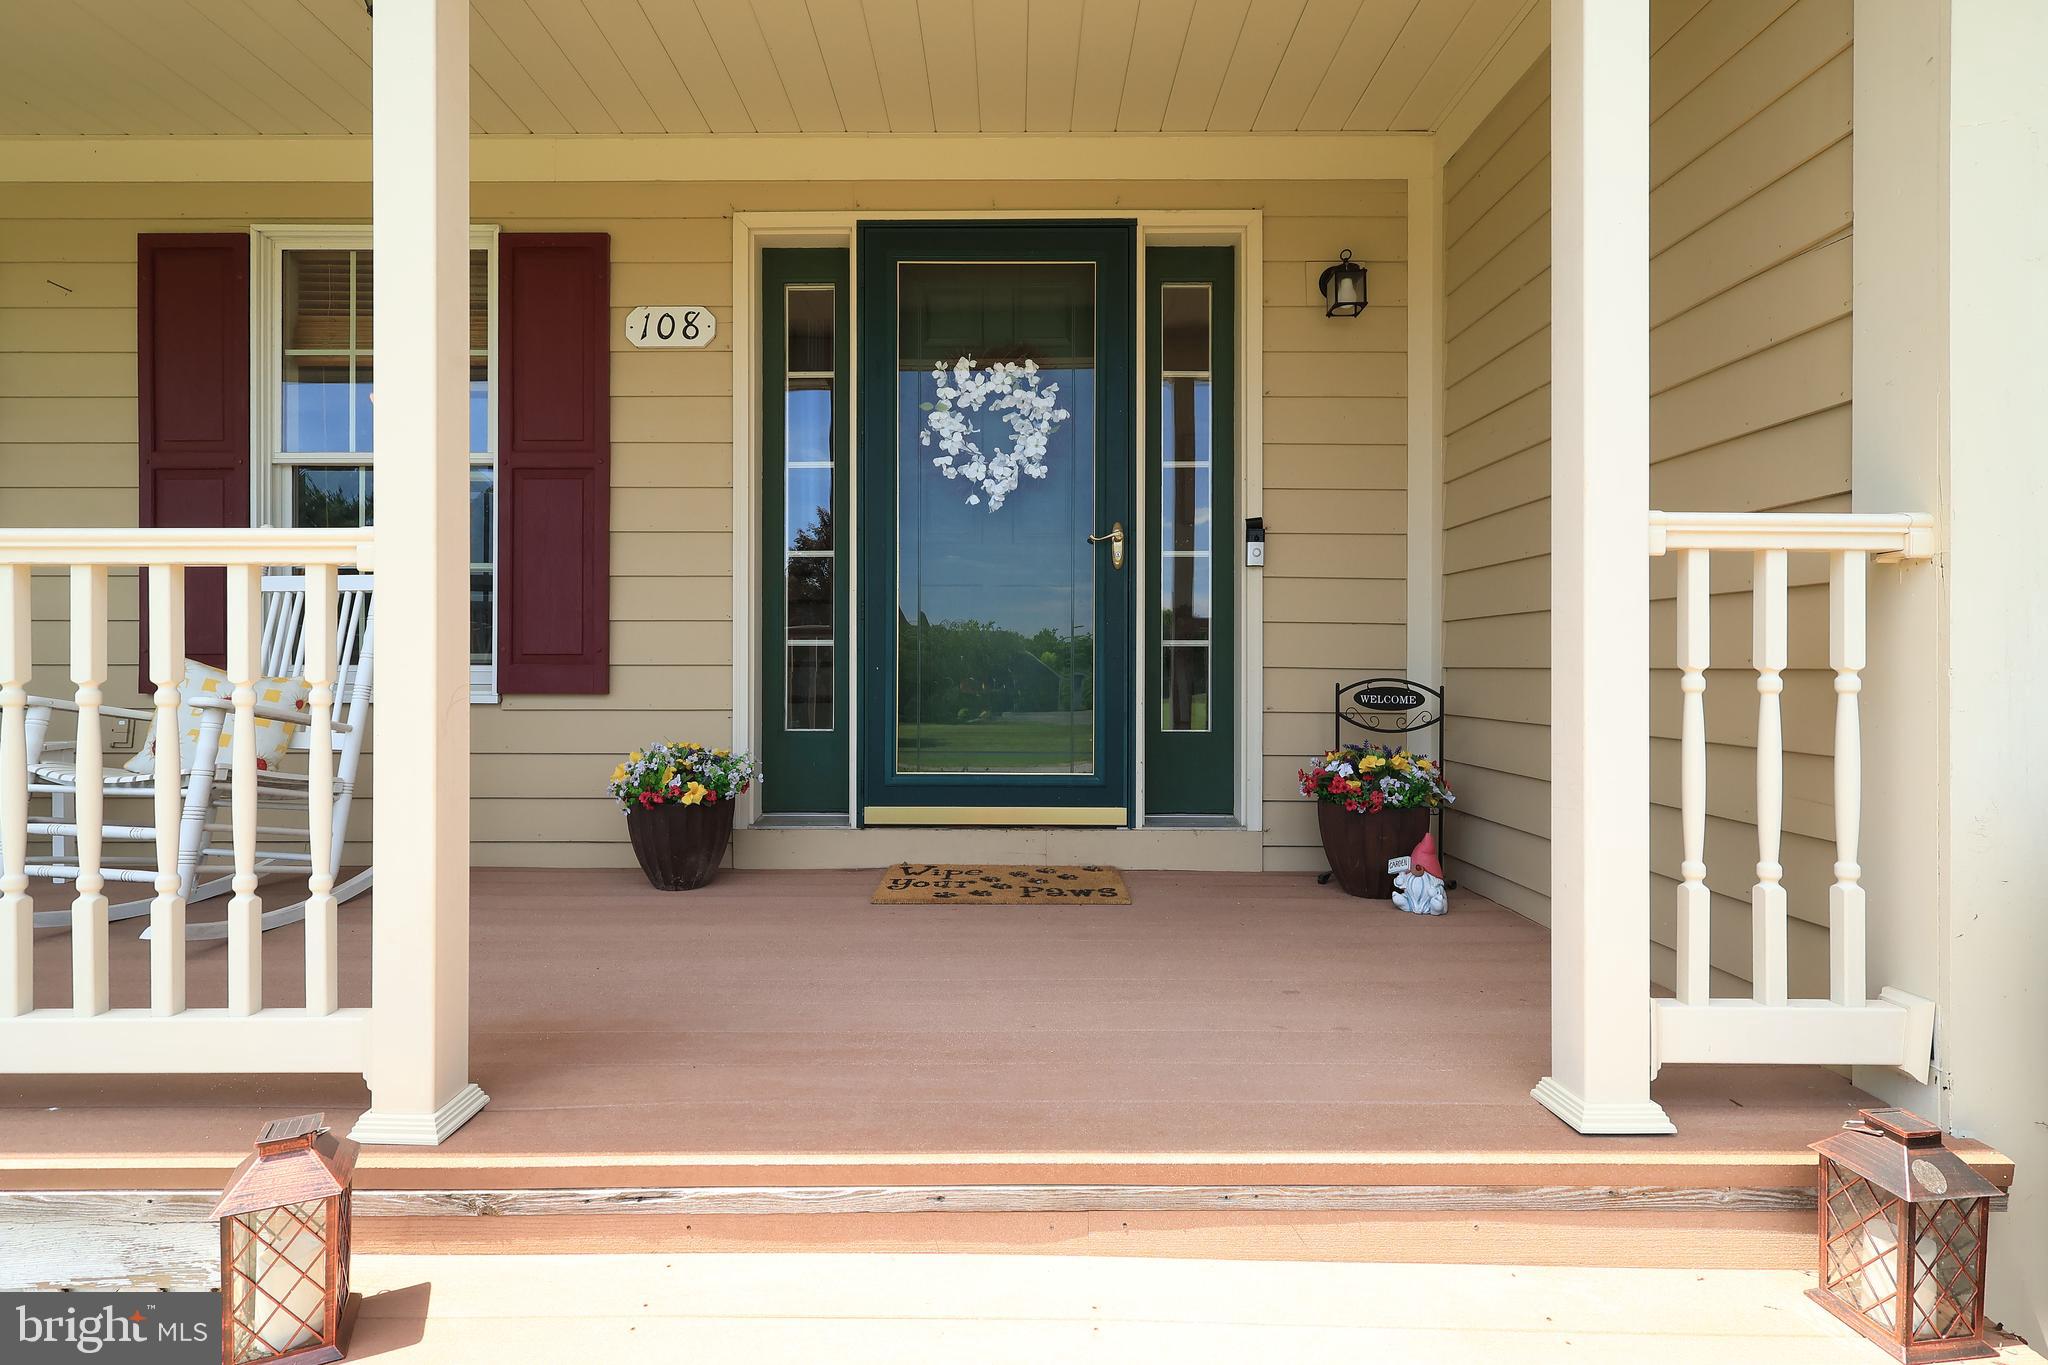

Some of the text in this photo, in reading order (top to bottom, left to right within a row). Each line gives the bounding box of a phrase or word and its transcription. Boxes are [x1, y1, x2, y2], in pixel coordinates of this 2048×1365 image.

[640, 311, 700, 341] 108
[1360, 694, 1417, 704] WELCOME
[900, 864, 983, 880] Wipe
[1019, 886, 1118, 898] Paws
